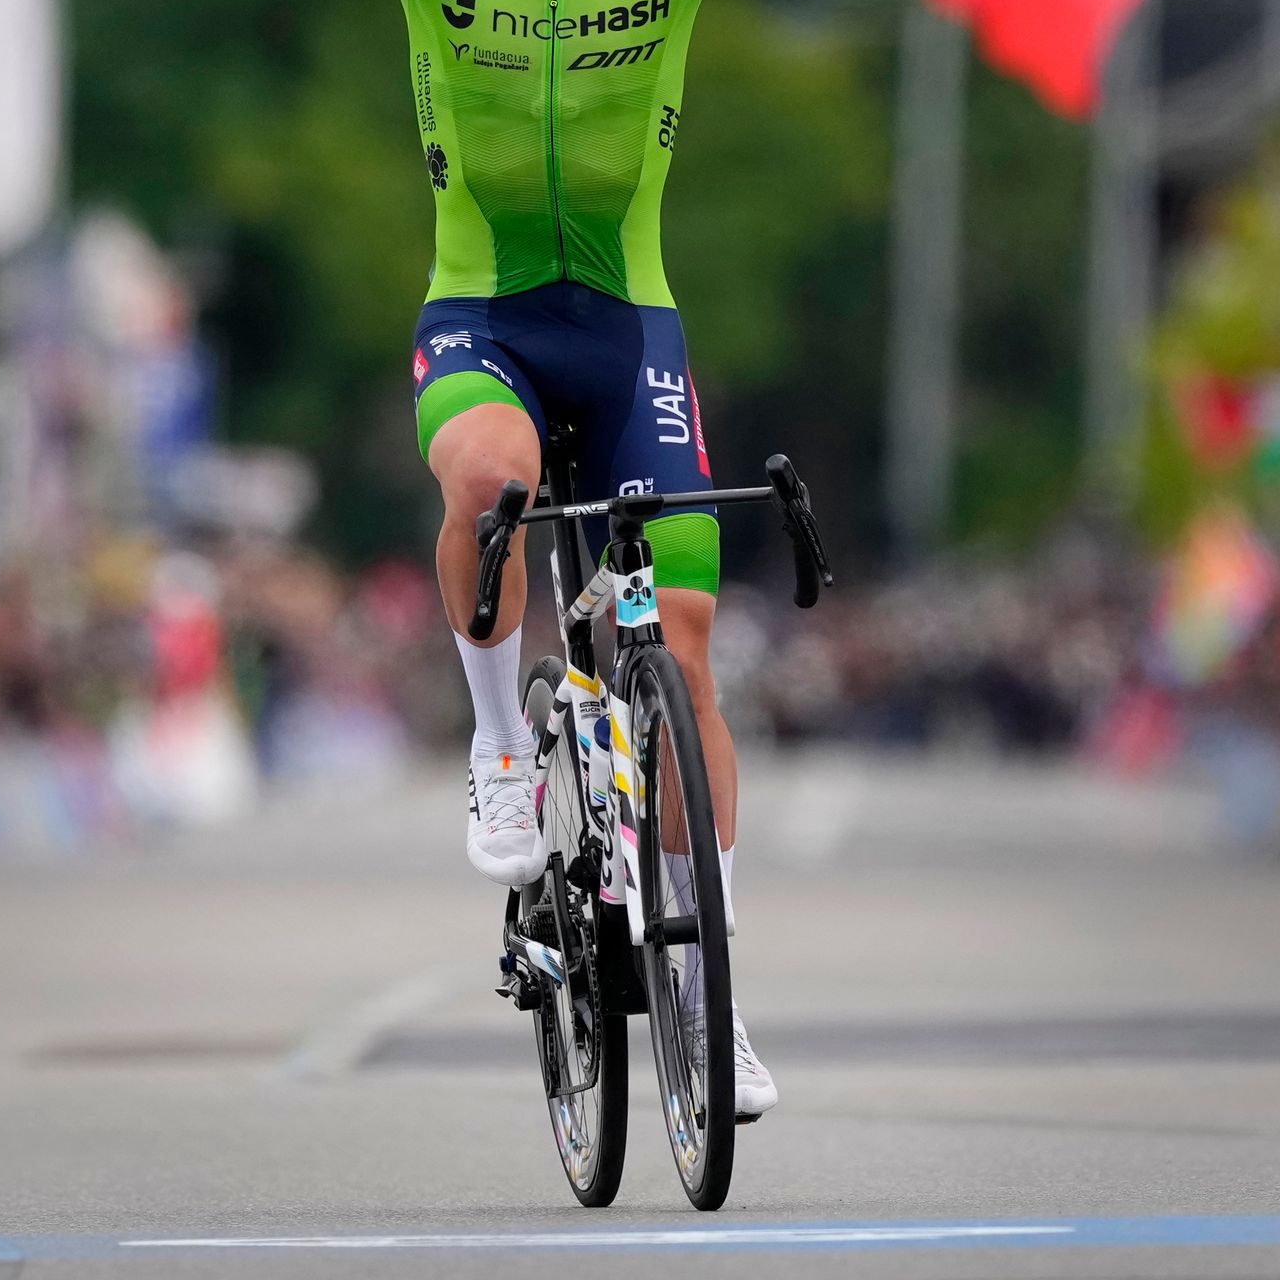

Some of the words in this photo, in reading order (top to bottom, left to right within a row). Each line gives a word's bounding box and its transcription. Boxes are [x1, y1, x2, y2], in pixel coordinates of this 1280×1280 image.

[416, 54, 428, 133] Telekom
[422, 51, 437, 132] Slovenije
[646, 367, 690, 445] UAE
